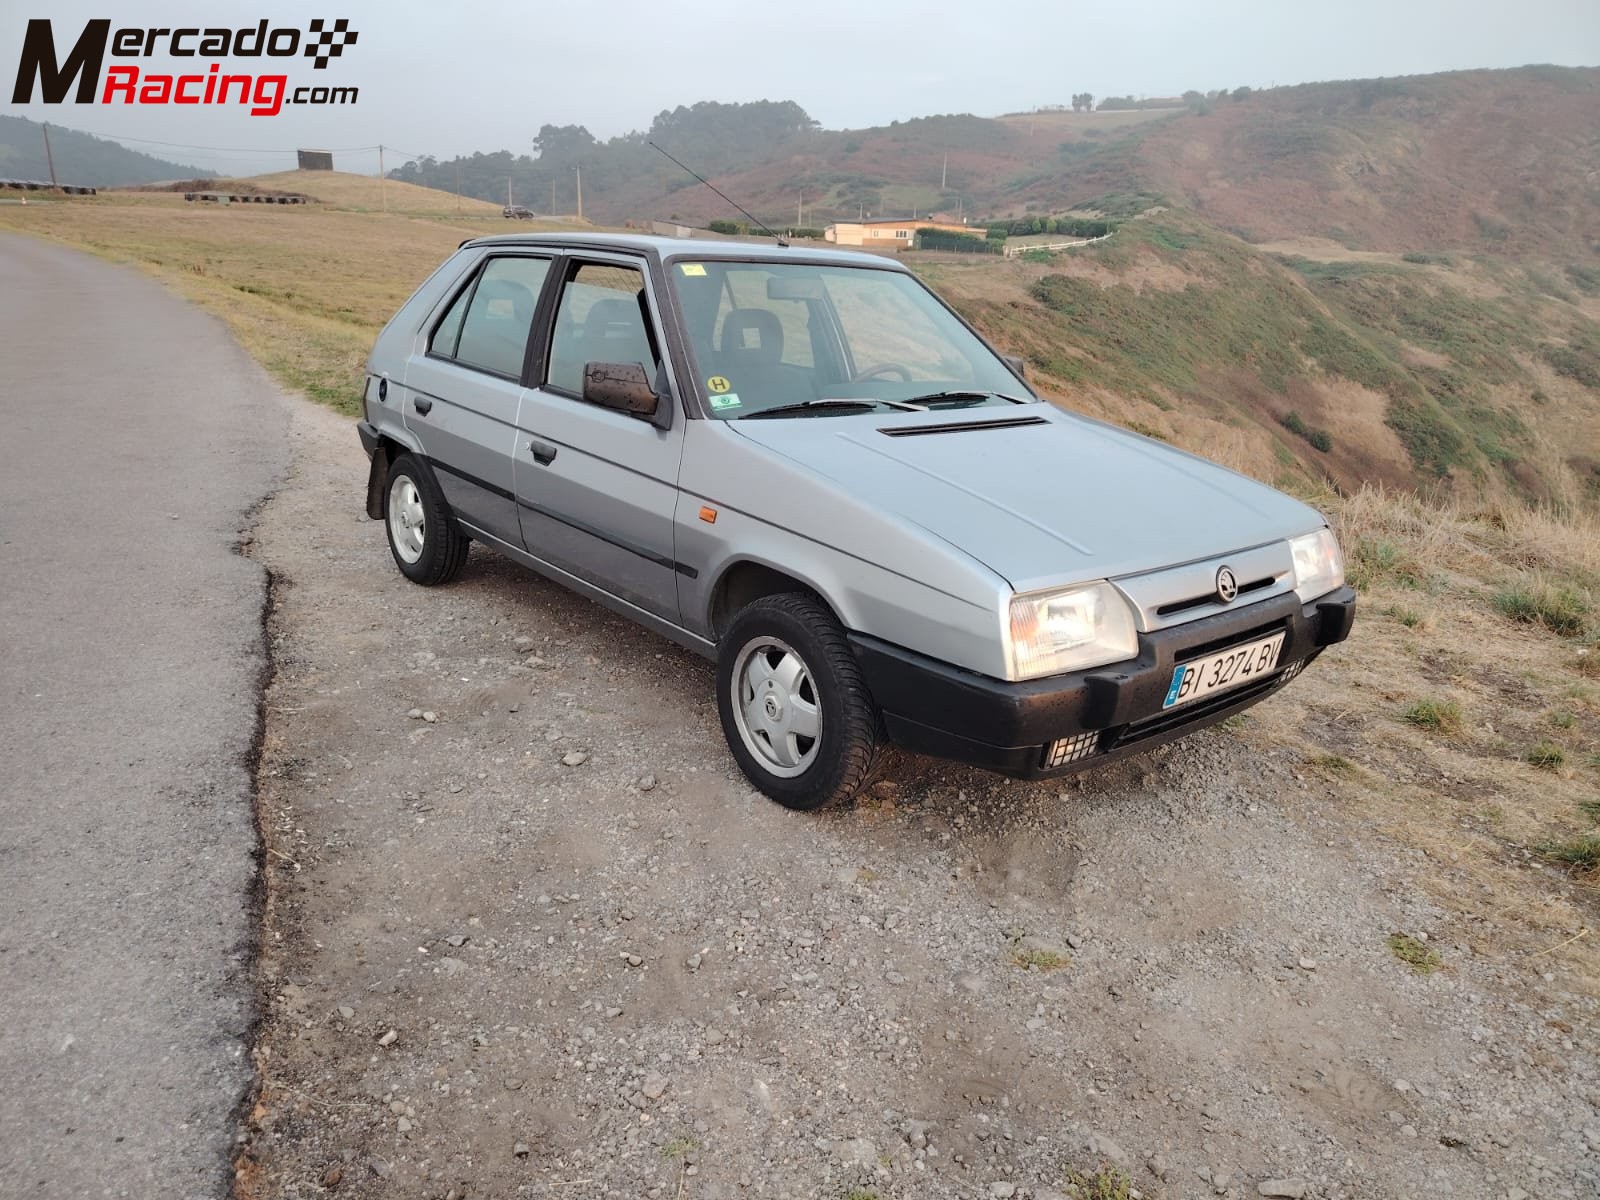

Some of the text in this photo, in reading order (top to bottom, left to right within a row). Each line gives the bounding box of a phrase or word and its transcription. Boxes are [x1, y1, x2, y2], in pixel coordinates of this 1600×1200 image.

[711, 378, 726, 390] H
[1177, 638, 1282, 699] BI 3274 BV
